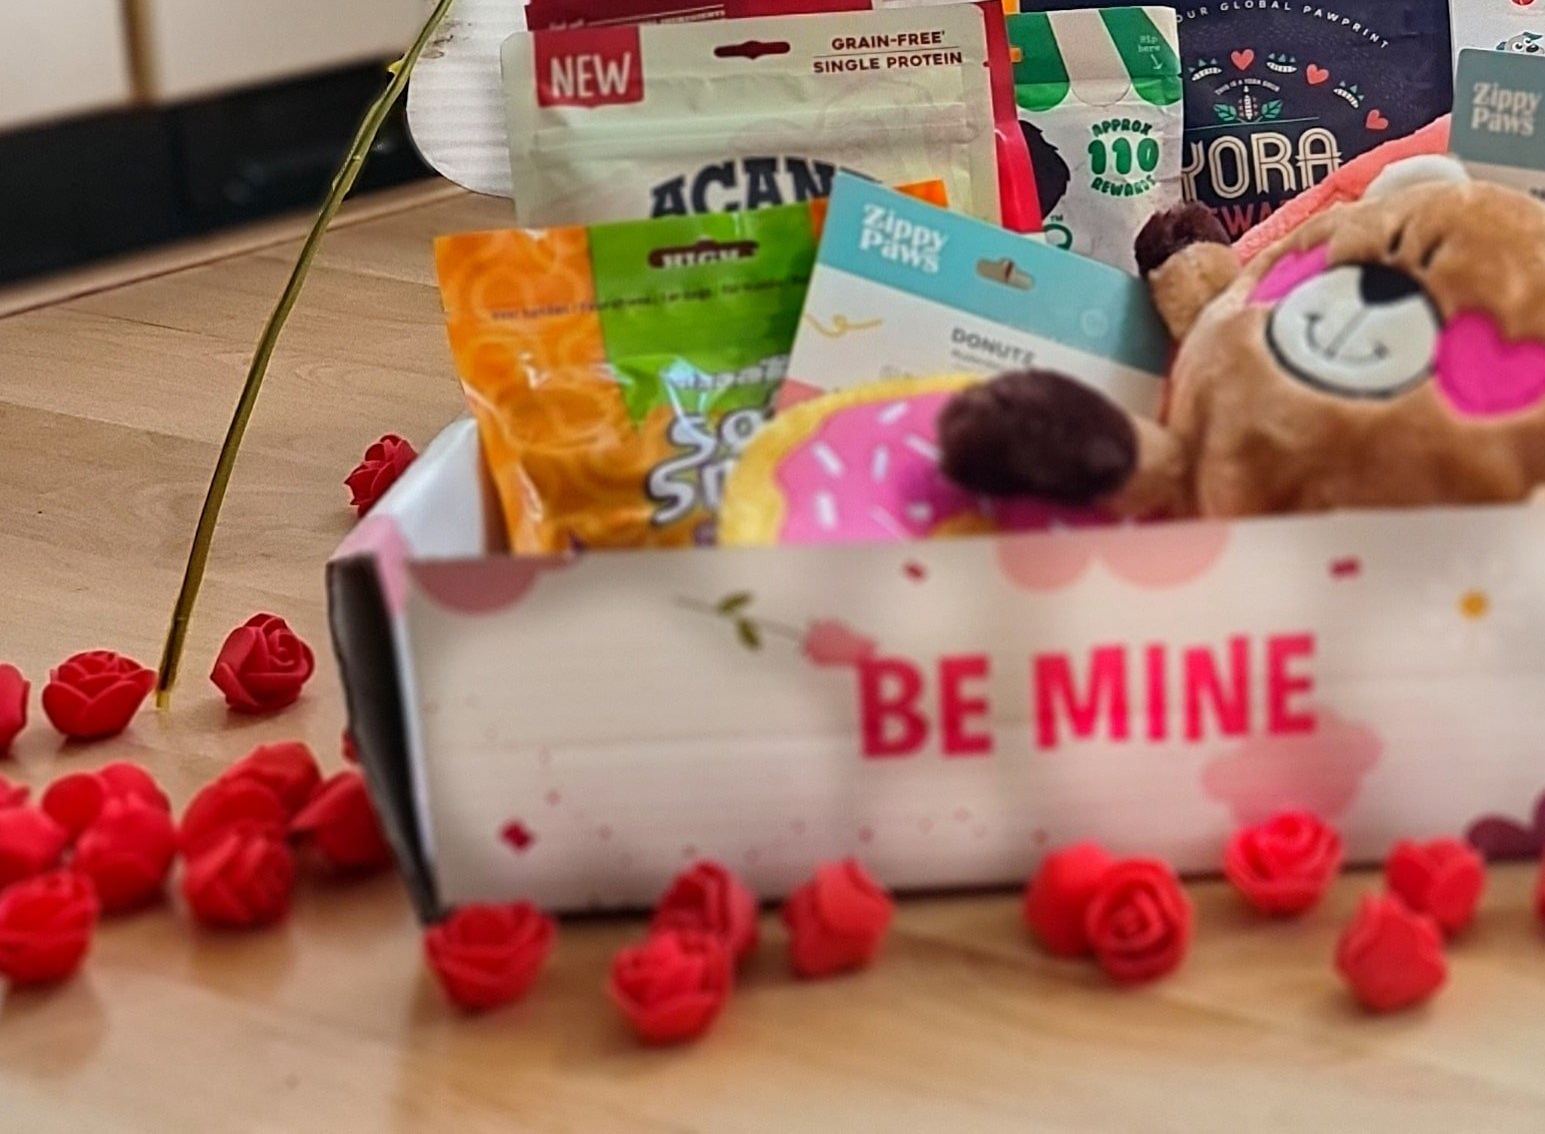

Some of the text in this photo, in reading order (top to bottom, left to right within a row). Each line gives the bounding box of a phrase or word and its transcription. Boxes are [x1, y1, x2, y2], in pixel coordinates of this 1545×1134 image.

[1220, 0, 1291, 11] GLOBAL
[1302, 4, 1389, 49] PAWPRINT
[550, 51, 631, 98] NEW
[813, 52, 963, 73] SINGLE PROTEIN
[1471, 106, 1535, 136] Paws
[1472, 81, 1542, 115] Zippy
[1091, 118, 1152, 137] APPROX
[1087, 137, 1160, 175] 110
[1181, 127, 1343, 202] YORA
[651, 156, 860, 218] ACAN
[1091, 174, 1156, 197] REWARDS
[859, 227, 939, 274] Paws
[862, 202, 948, 253] Zippy
[860, 632, 1317, 759] BE MINE
